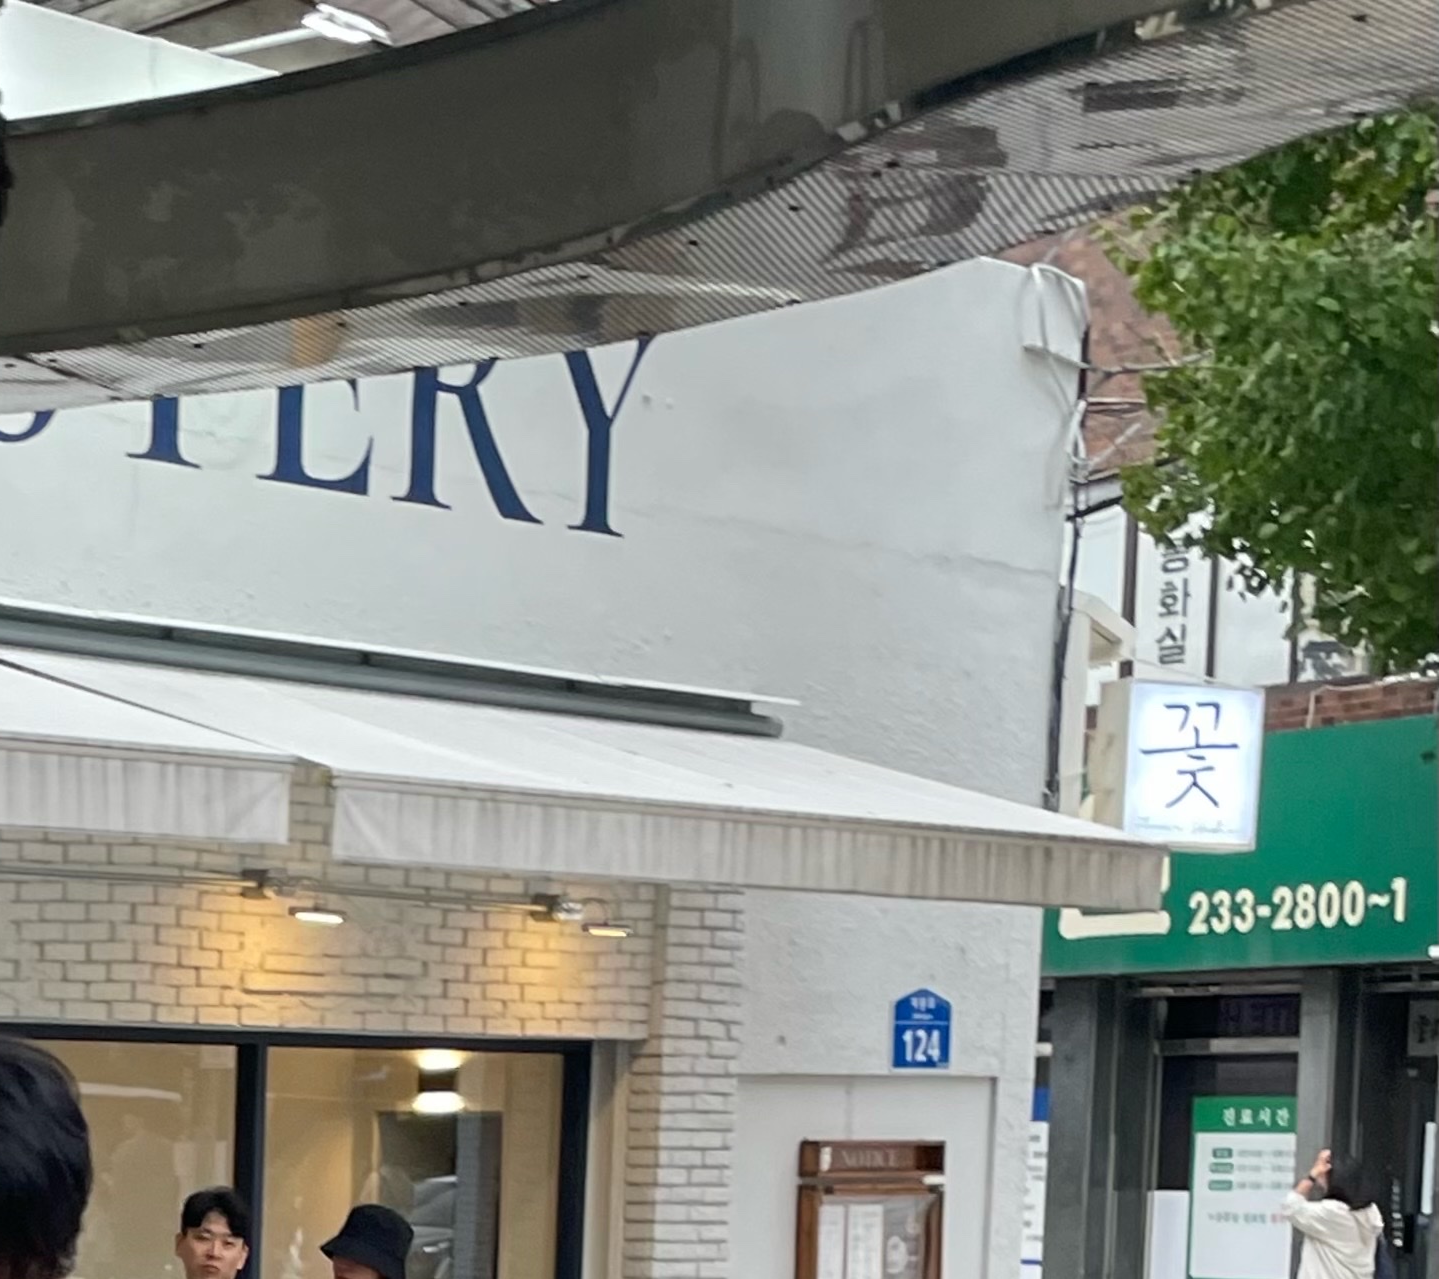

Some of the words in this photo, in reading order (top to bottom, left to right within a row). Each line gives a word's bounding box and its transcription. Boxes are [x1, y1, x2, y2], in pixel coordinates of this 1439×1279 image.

[1139, 702, 1240, 808] 꽃
[1187, 876, 1408, 935] 233-2800~1
[902, 1029, 941, 1063] 124
